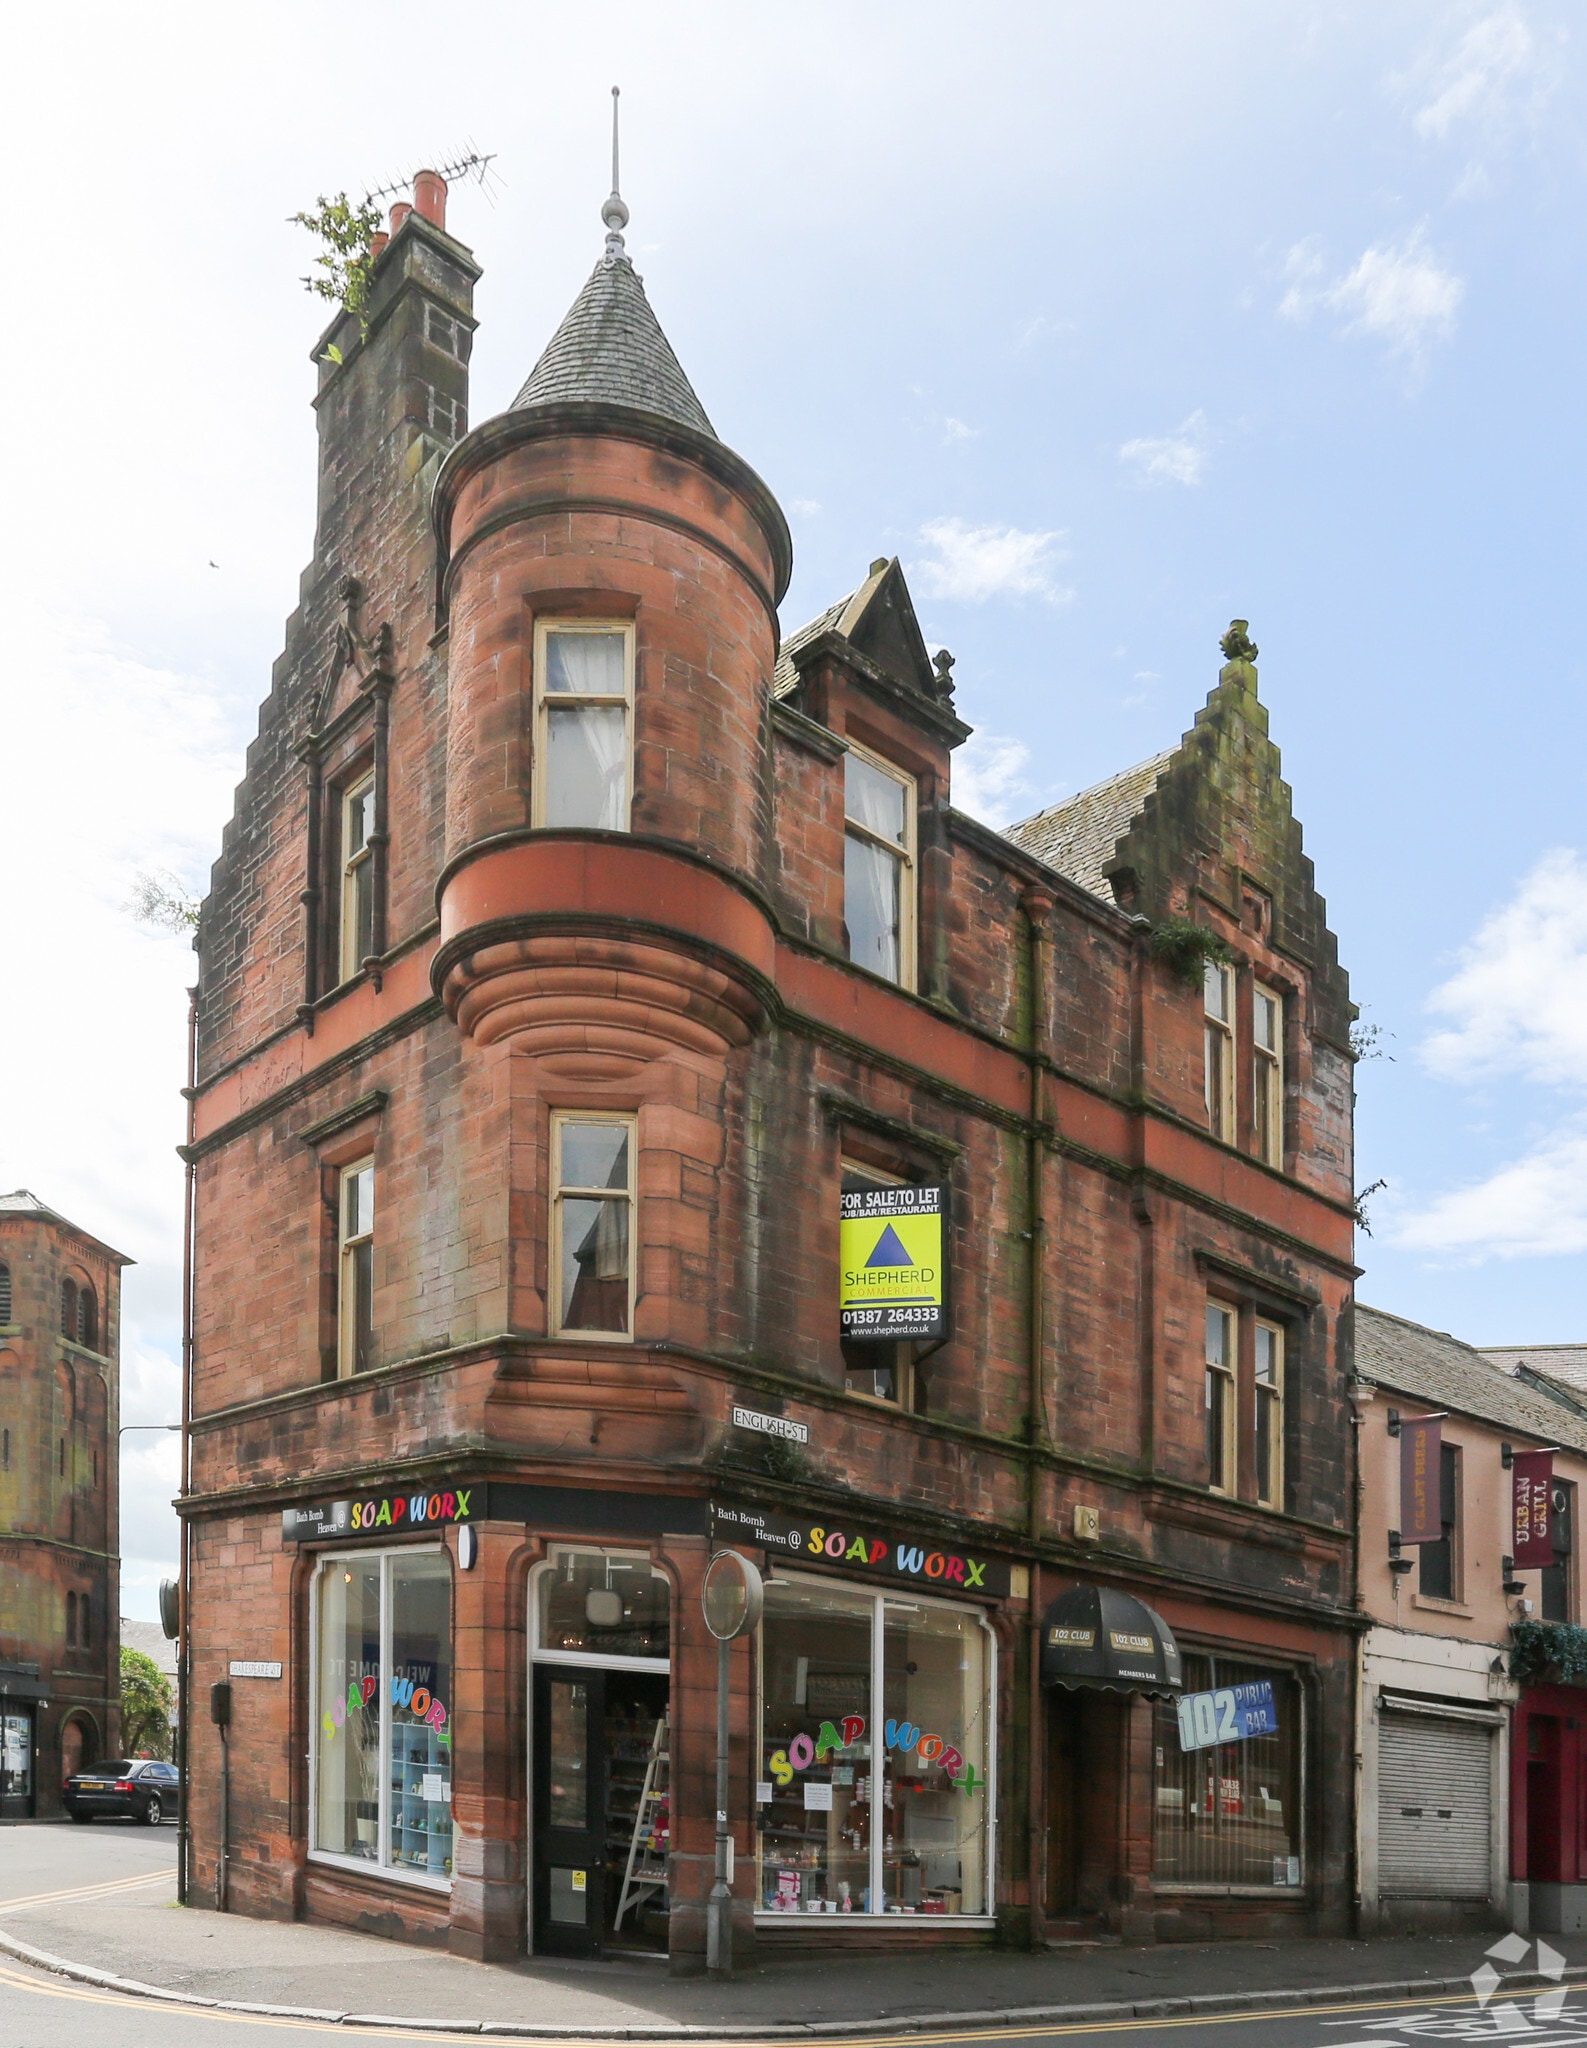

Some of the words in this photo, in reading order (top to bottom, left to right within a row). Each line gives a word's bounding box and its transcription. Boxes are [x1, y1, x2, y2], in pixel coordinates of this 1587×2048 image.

[841, 1193, 861, 1209] FOR
[866, 1189, 914, 1207] SALE/TO
[918, 1187, 940, 1204] LET
[845, 1268, 934, 1286] SHEPHERD
[850, 1286, 929, 1297] COMMERCIAL
[842, 1310, 882, 1324] 01387
[888, 1307, 939, 1322] 264333
[851, 1324, 929, 1336] www.shepherd.co.uk
[735, 1410, 786, 1436] ENGLISH
[308, 1509, 324, 1521] Bomb
[317, 1522, 338, 1534] Heaven
[351, 1497, 406, 1530] SOAP
[410, 1490, 471, 1522] WORX
[717, 1508, 738, 1522] Bath
[740, 1511, 765, 1527] Bomb
[1516, 1477, 1530, 1545] URBAN
[1533, 1480, 1547, 1538] GRILL
[755, 1528, 787, 1545] Heaven
[788, 1530, 802, 1549] @
[808, 1527, 888, 1564] SOAP
[896, 1544, 986, 1587] WORX
[1055, 1629, 1069, 1639] 102
[1071, 1631, 1090, 1640] CLUB
[1115, 1633, 1128, 1644] 102
[1130, 1636, 1149, 1646] CLUB
[1118, 1669, 1145, 1678] MEMBERS
[1235, 1682, 1272, 1709] PUBLIC
[323, 1675, 376, 1740] SOAP
[1179, 1689, 1239, 1749] 102
[1246, 1710, 1268, 1735] BAR
[769, 1715, 865, 1785] SOAP
[885, 1719, 987, 1798] WORX
